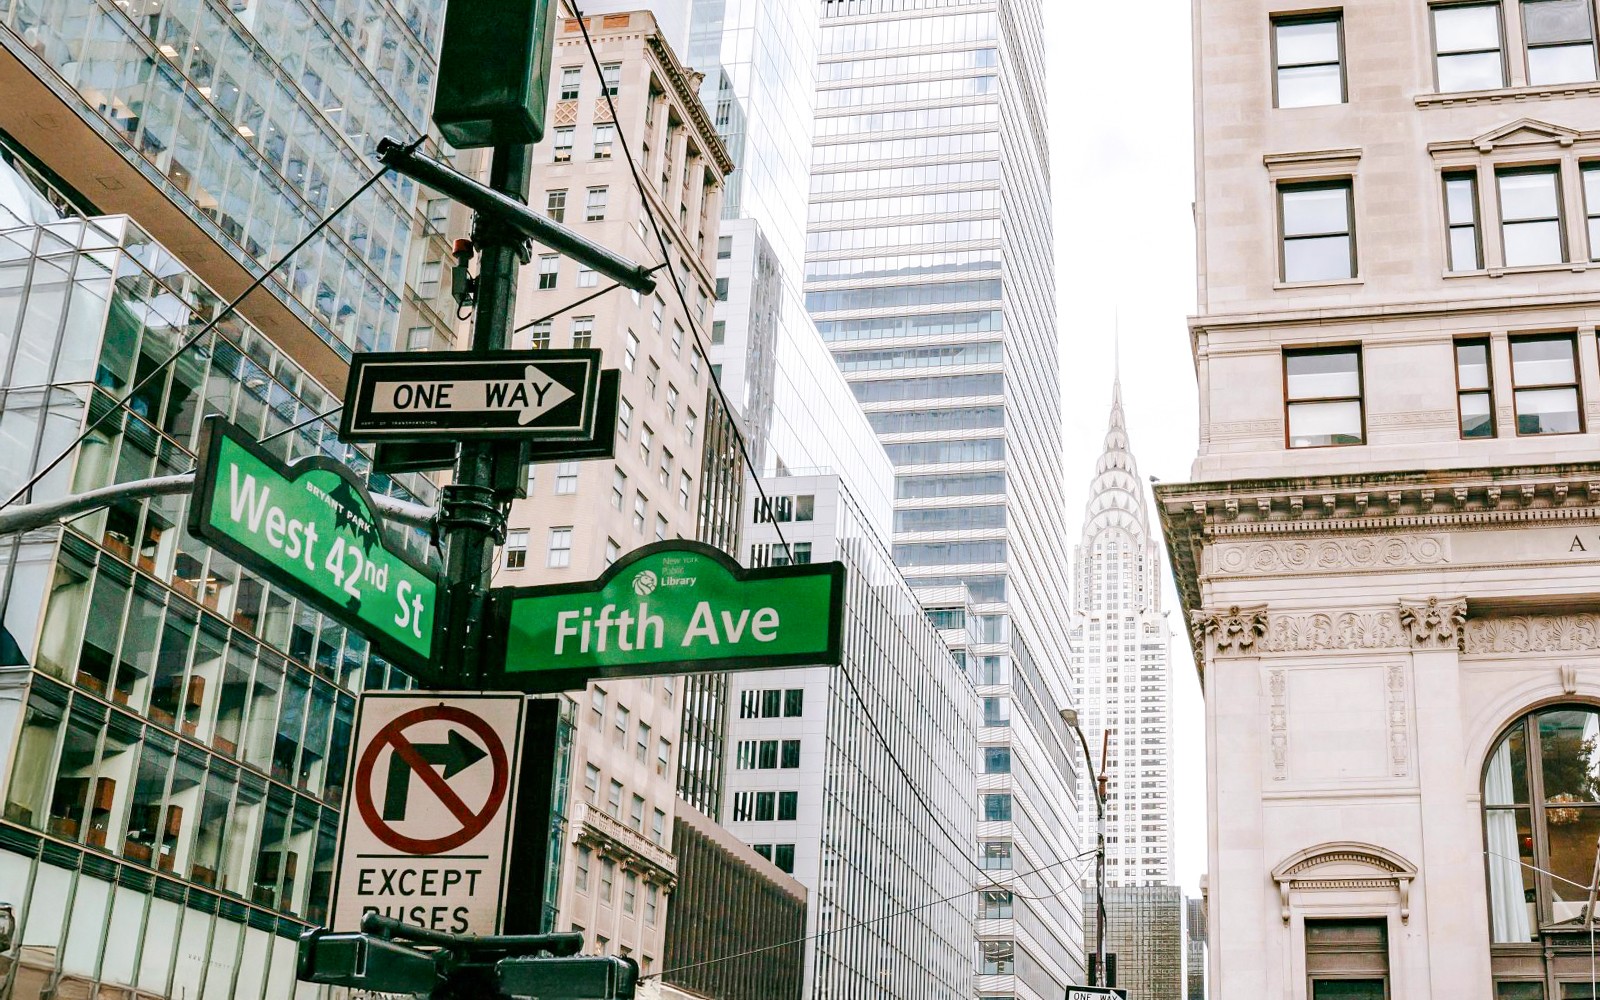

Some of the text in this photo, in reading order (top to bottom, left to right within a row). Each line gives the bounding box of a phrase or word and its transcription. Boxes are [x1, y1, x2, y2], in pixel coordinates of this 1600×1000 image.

[393, 382, 553, 409] ONE WAY
[306, 481, 371, 534] BRYANT PARK
[230, 463, 424, 639] West 42nd St
[662, 556, 699, 565] New York
[661, 576, 697, 587] Library
[662, 566, 685, 575] Public
[554, 601, 780, 655] Fifth Ave
[358, 868, 482, 896] EXCEPT
[362, 906, 469, 934] SES
